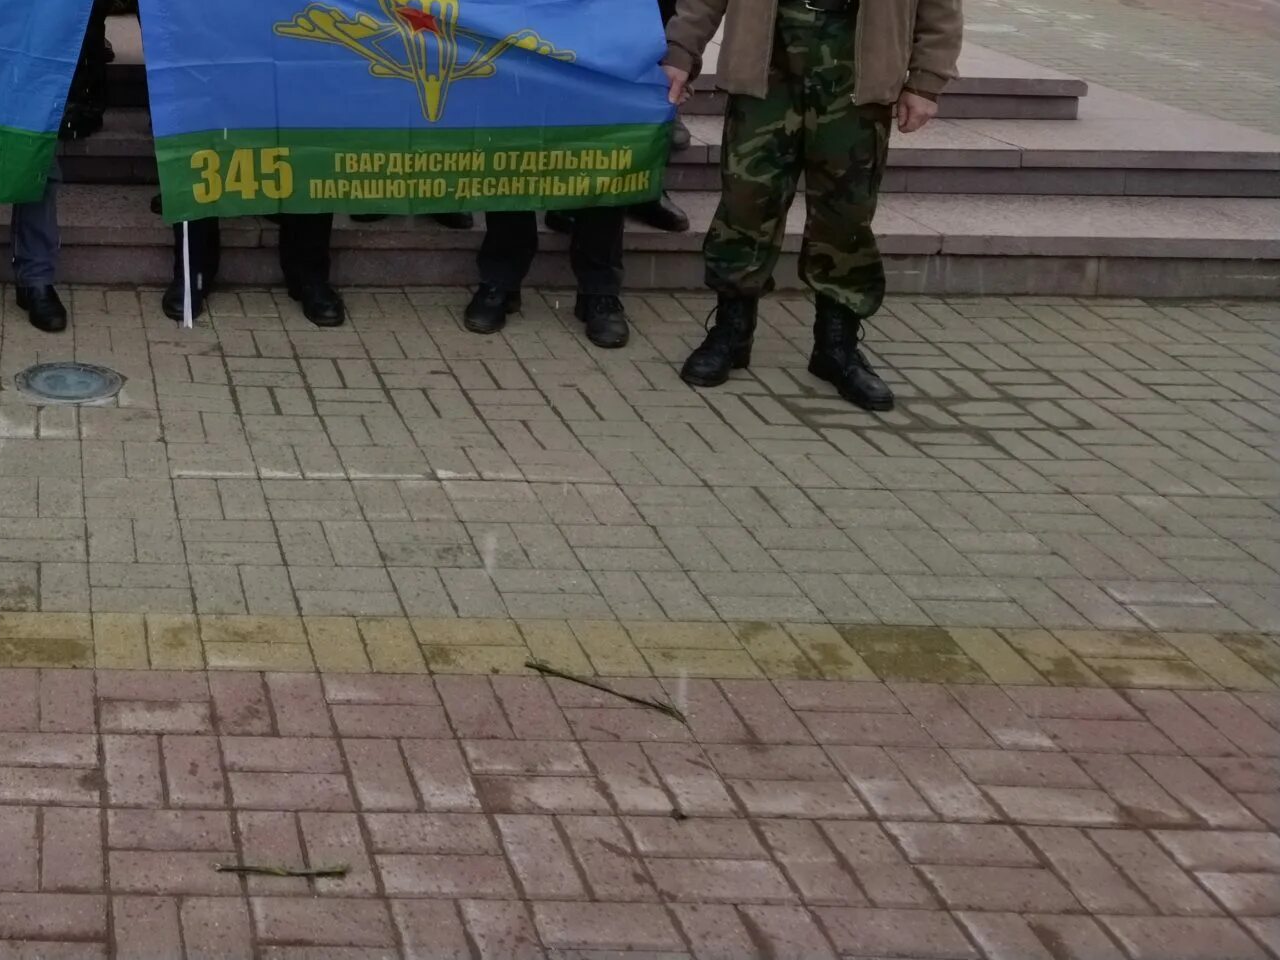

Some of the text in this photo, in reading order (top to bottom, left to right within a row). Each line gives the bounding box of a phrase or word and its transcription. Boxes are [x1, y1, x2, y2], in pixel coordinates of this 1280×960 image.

[334, 145, 633, 175] ГВАРДЕЙСКИЙ ОТДЕЛЬНЫЙ
[190, 147, 294, 204] 345
[309, 170, 651, 200] ПАРАШЮТНО-ДЕСАНТНЫЙ ПОЛК
